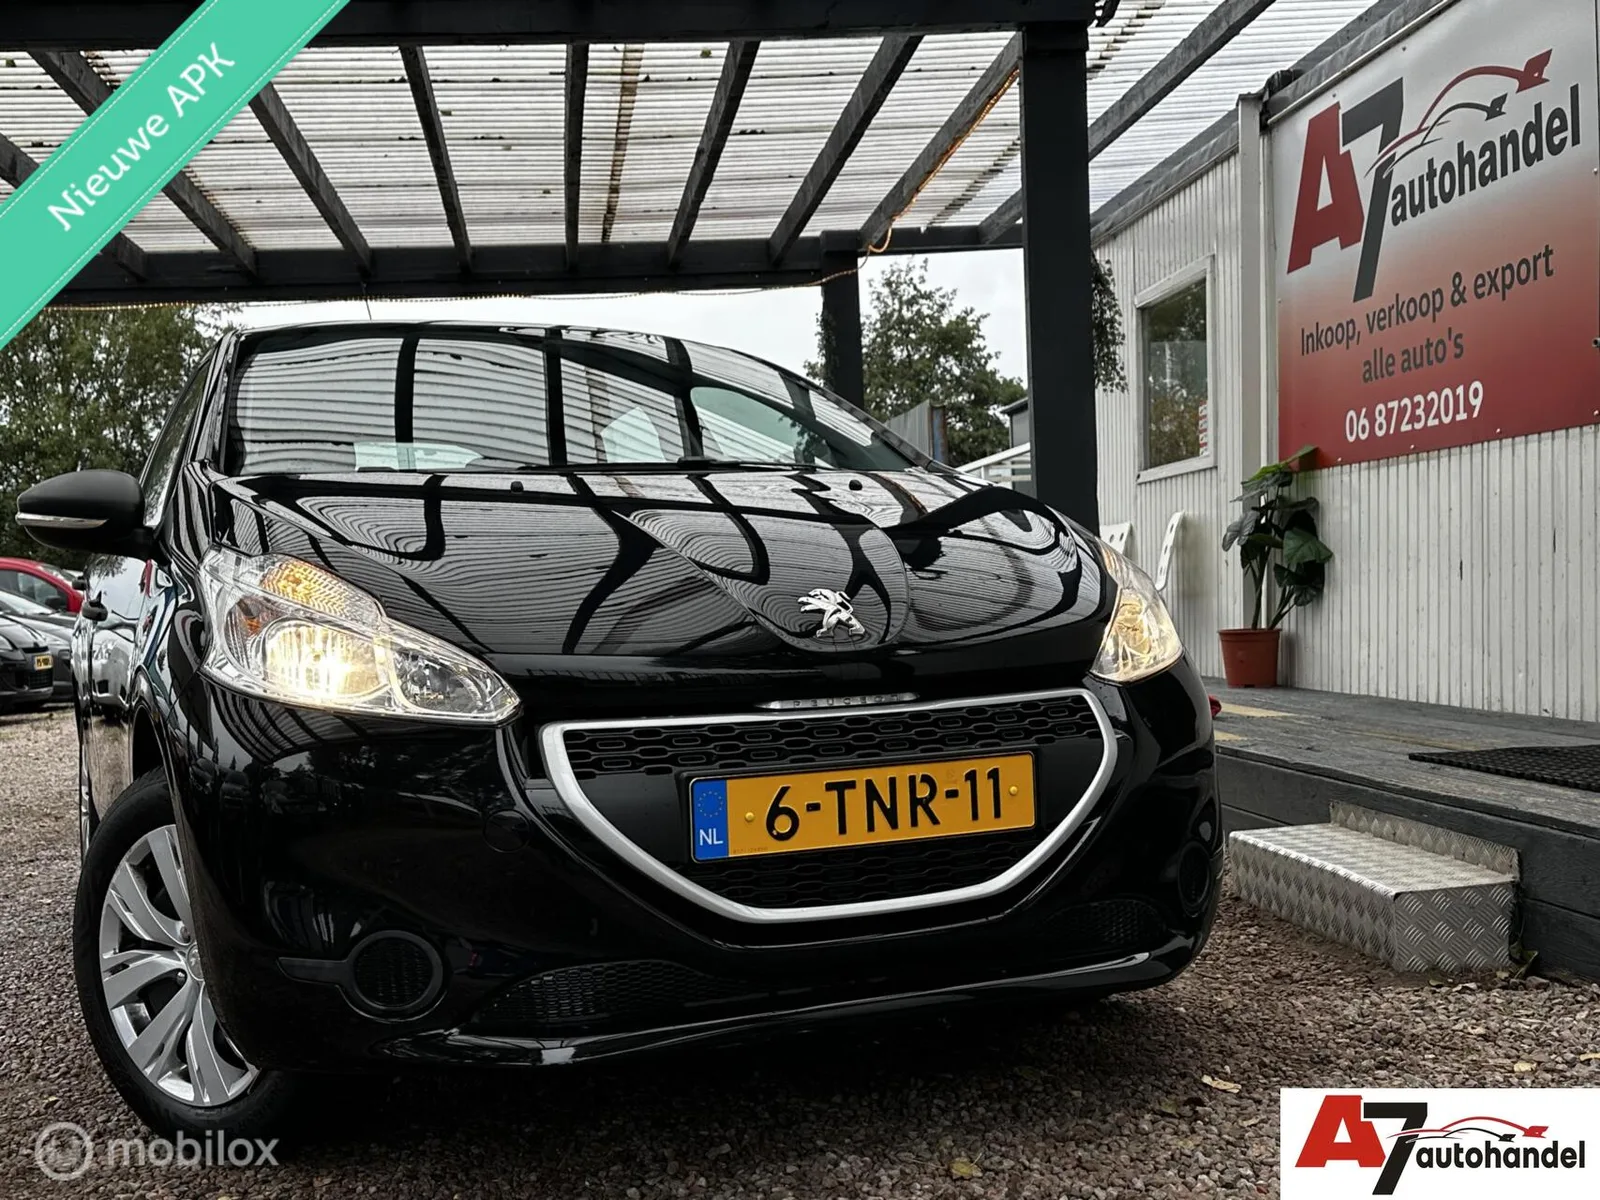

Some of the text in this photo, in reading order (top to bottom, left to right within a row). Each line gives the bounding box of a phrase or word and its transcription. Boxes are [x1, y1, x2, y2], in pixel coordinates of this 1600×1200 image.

[1287, 77, 1581, 302] A7 autohandel
[1301, 244, 1555, 356] Inkoop, verkoop & export
[1362, 327, 1465, 384] alle auto's
[1345, 380, 1484, 443] 06 87232019
[699, 828, 724, 846] NL
[765, 766, 1001, 842] 6-TNR-11
